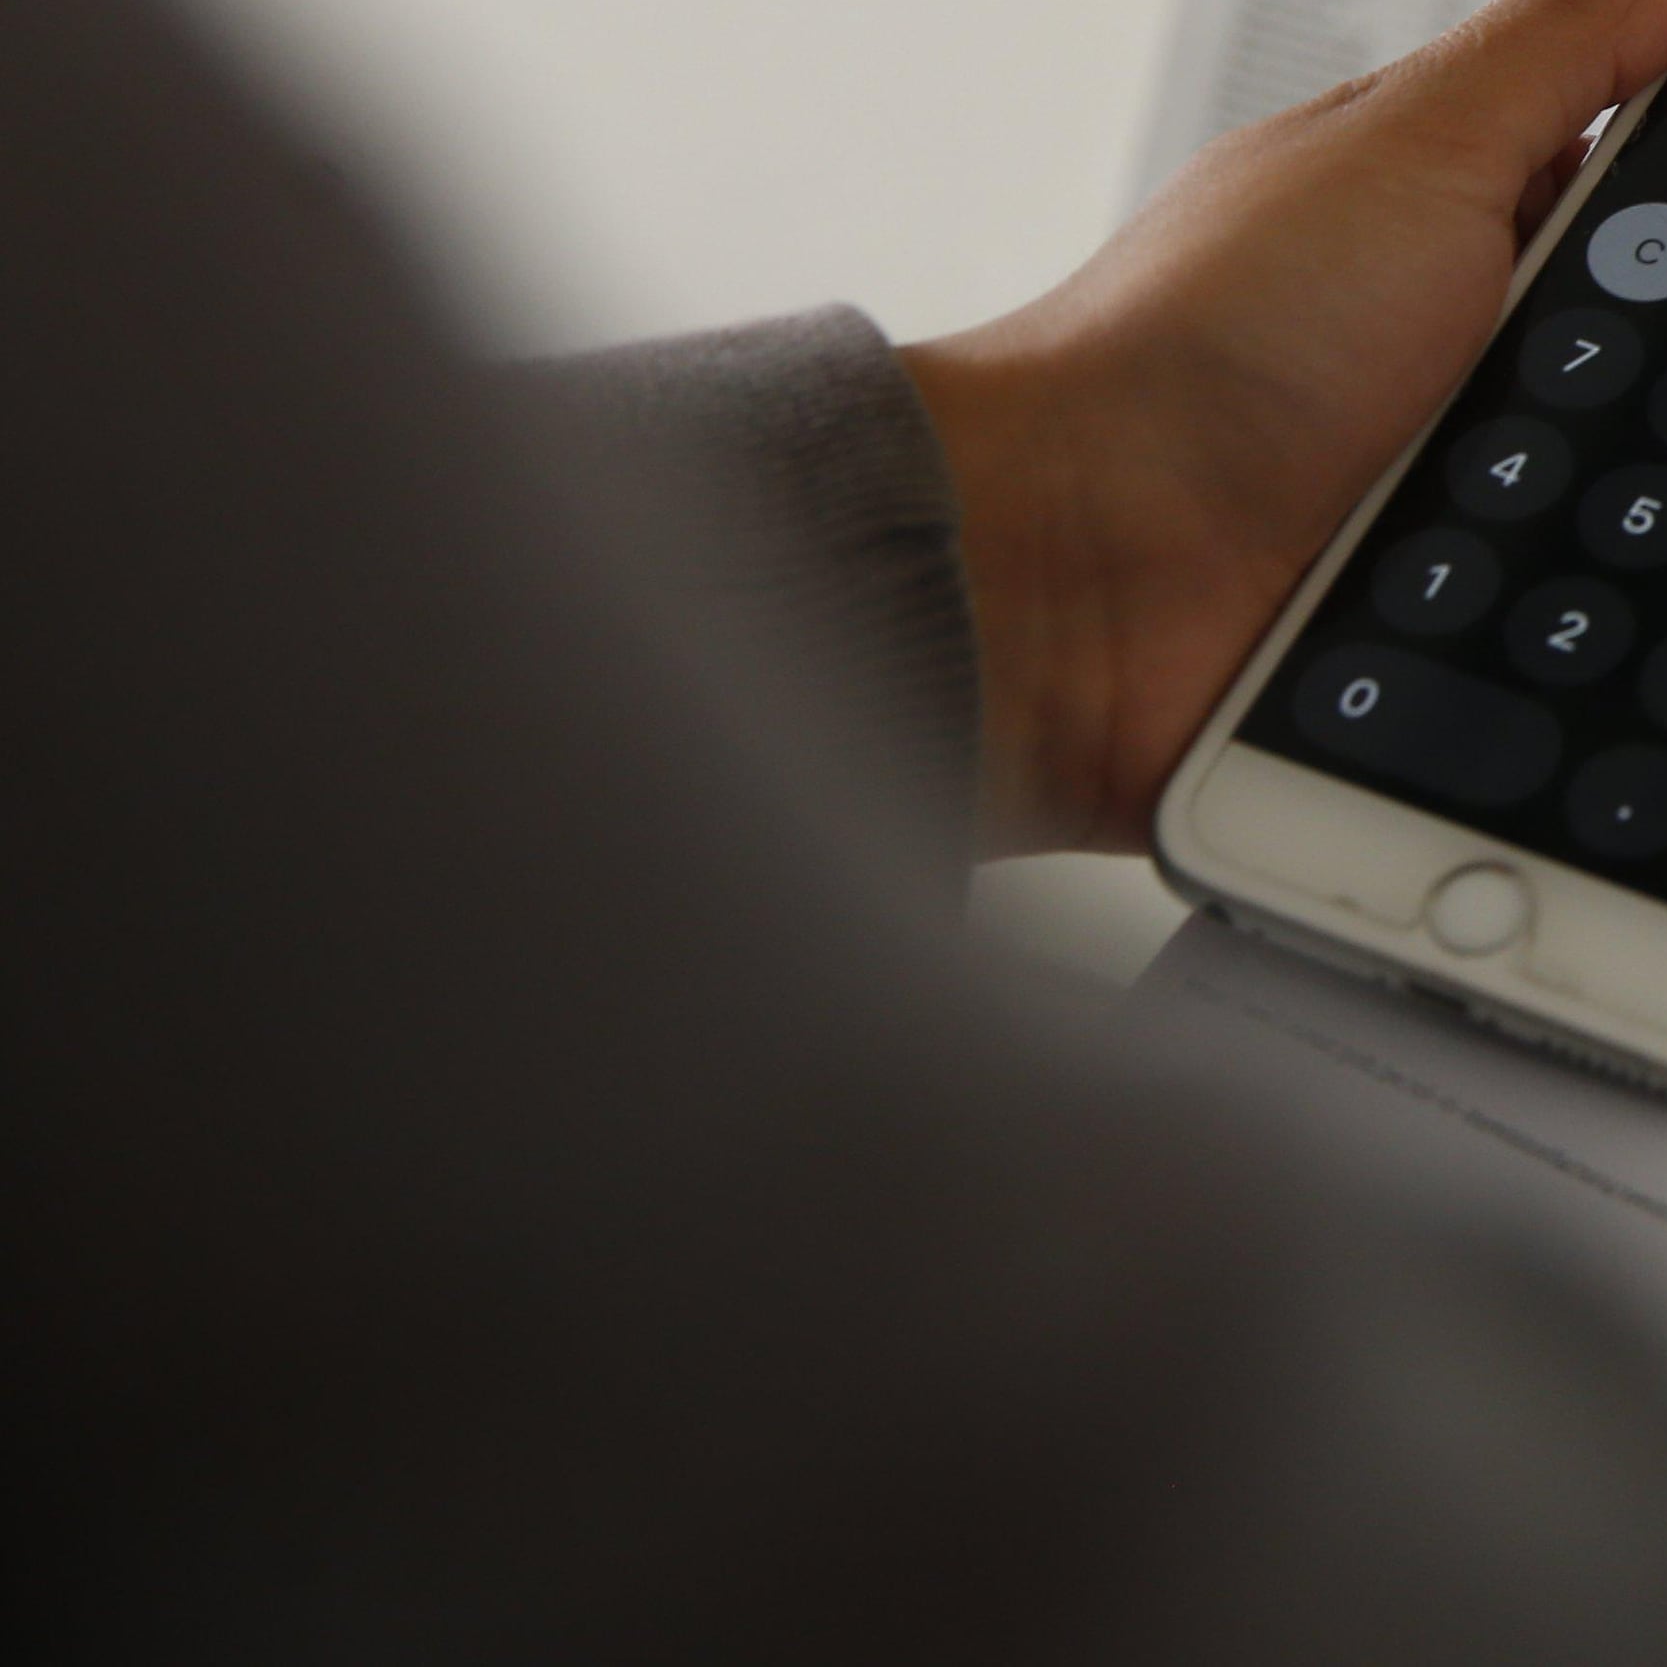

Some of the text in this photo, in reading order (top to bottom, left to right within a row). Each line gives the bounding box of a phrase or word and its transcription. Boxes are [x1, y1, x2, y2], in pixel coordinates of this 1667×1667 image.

[1633, 236, 1667, 267] C
[1562, 340, 1602, 374] 7
[1489, 452, 1531, 487] 4
[1621, 496, 1663, 535] 5
[1422, 563, 1452, 600] 1
[1547, 612, 1591, 652] 2
[1338, 679, 1381, 719] 0
